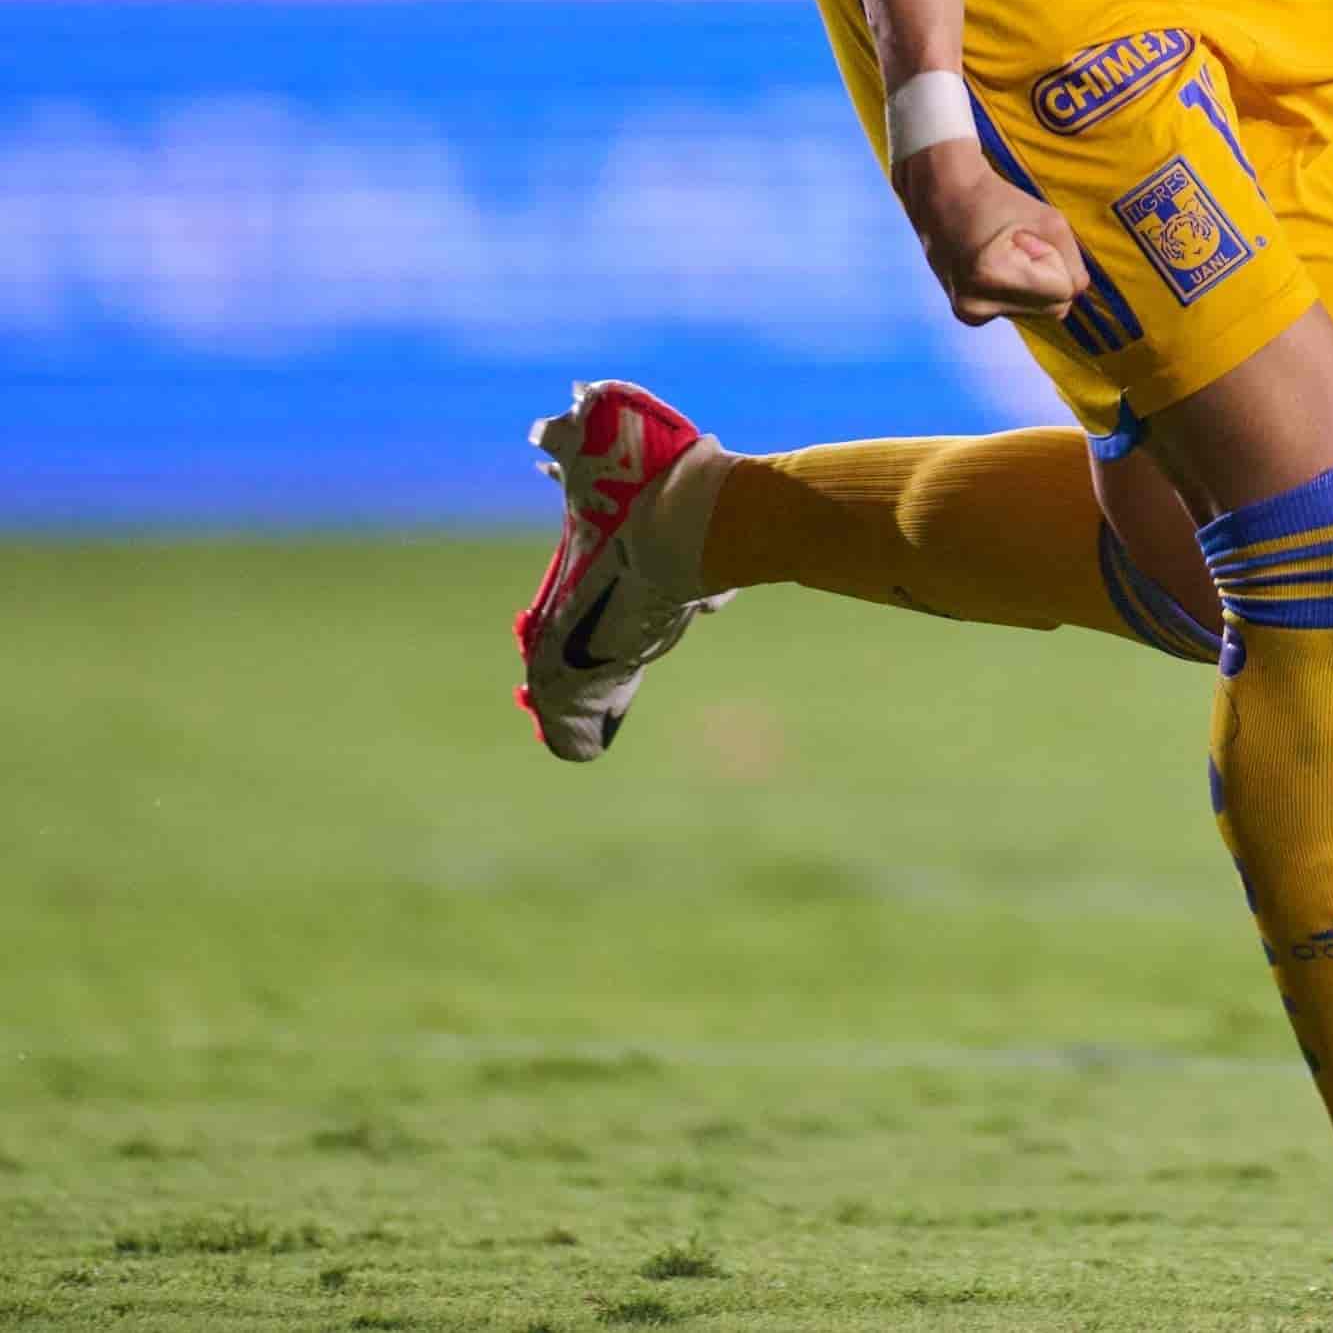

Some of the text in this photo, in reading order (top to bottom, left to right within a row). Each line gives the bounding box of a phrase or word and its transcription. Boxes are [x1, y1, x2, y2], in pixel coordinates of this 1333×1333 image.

[1045, 29, 1179, 120] CHIMEX
[1127, 171, 1188, 220] TIGRES
[1189, 251, 1230, 284] UANL
